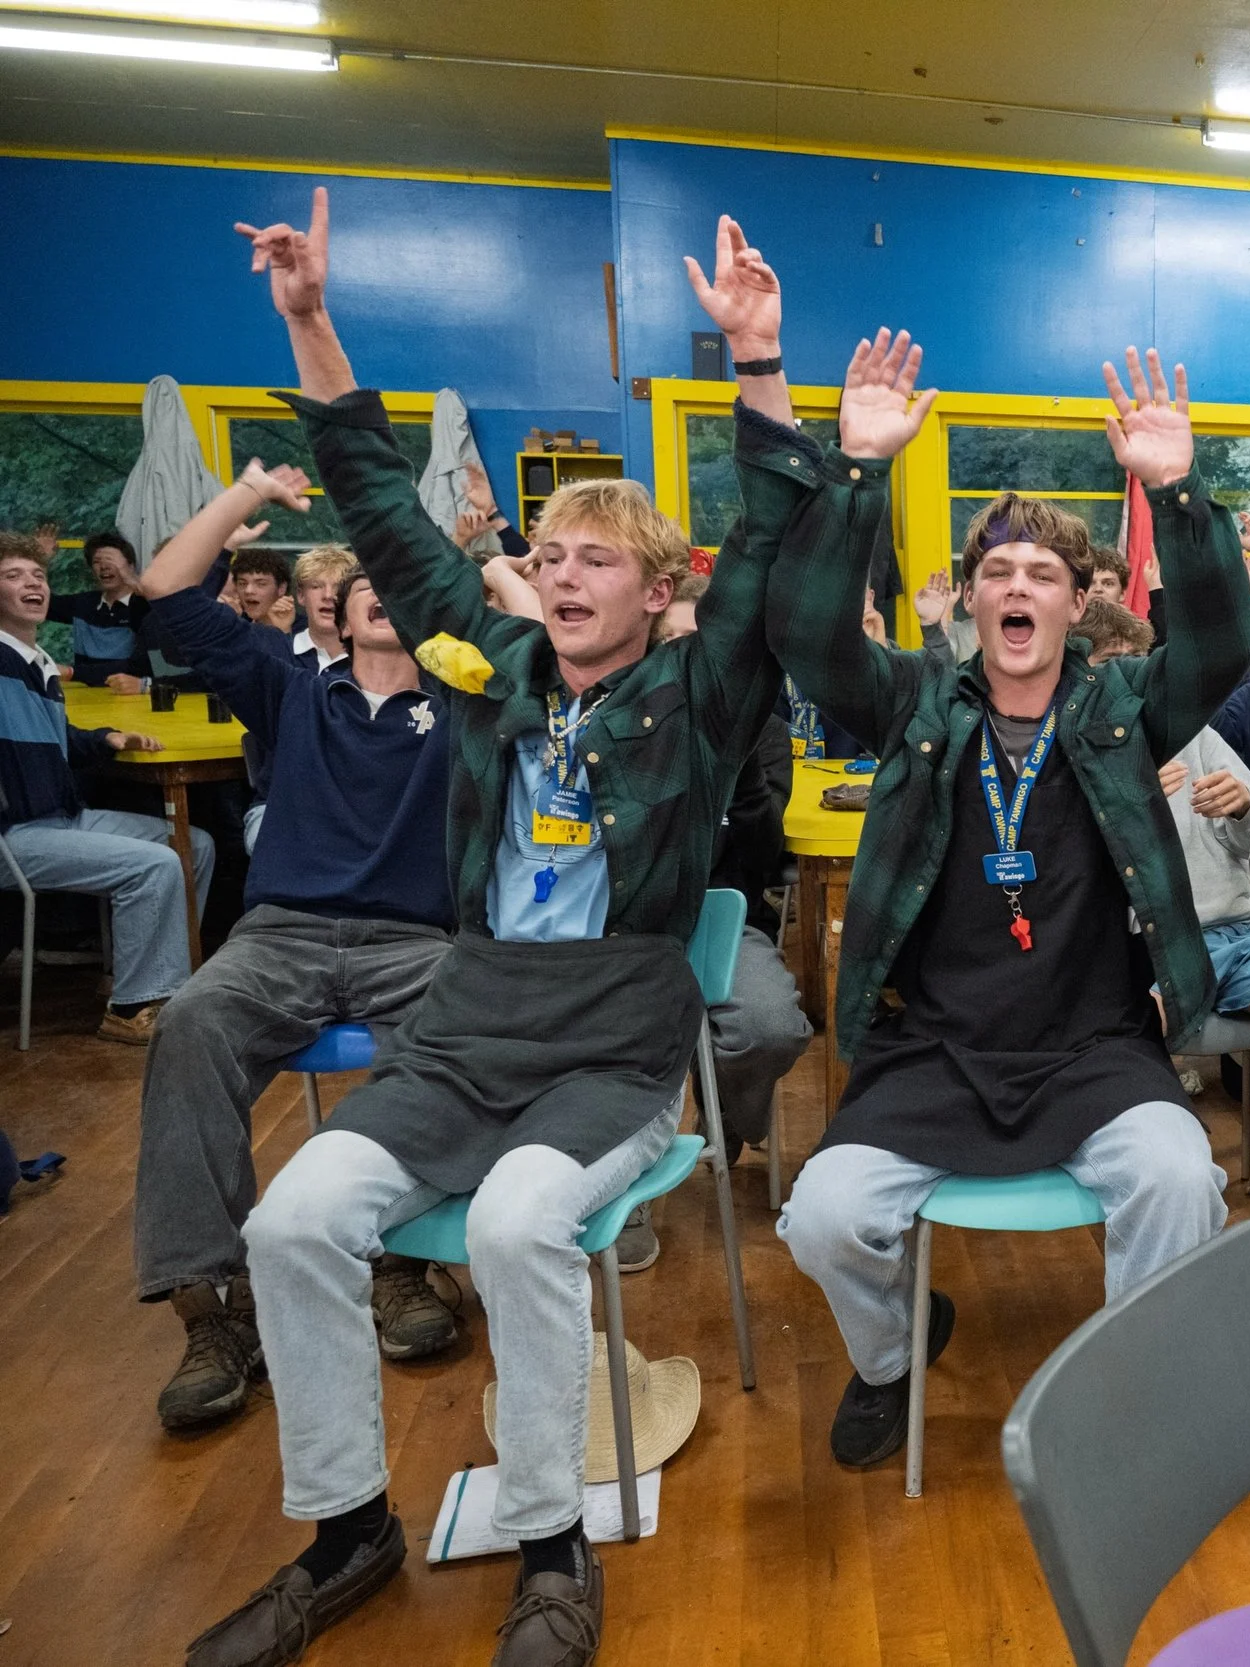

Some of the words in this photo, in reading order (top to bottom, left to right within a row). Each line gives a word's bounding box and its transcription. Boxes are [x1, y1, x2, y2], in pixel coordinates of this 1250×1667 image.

[1031, 740, 1044, 764] CAMP
[557, 790, 578, 799] JAMIE
[987, 783, 1001, 809] CAMP
[1009, 783, 1028, 827] TAWINGO
[1006, 828, 1018, 851] CAMP
